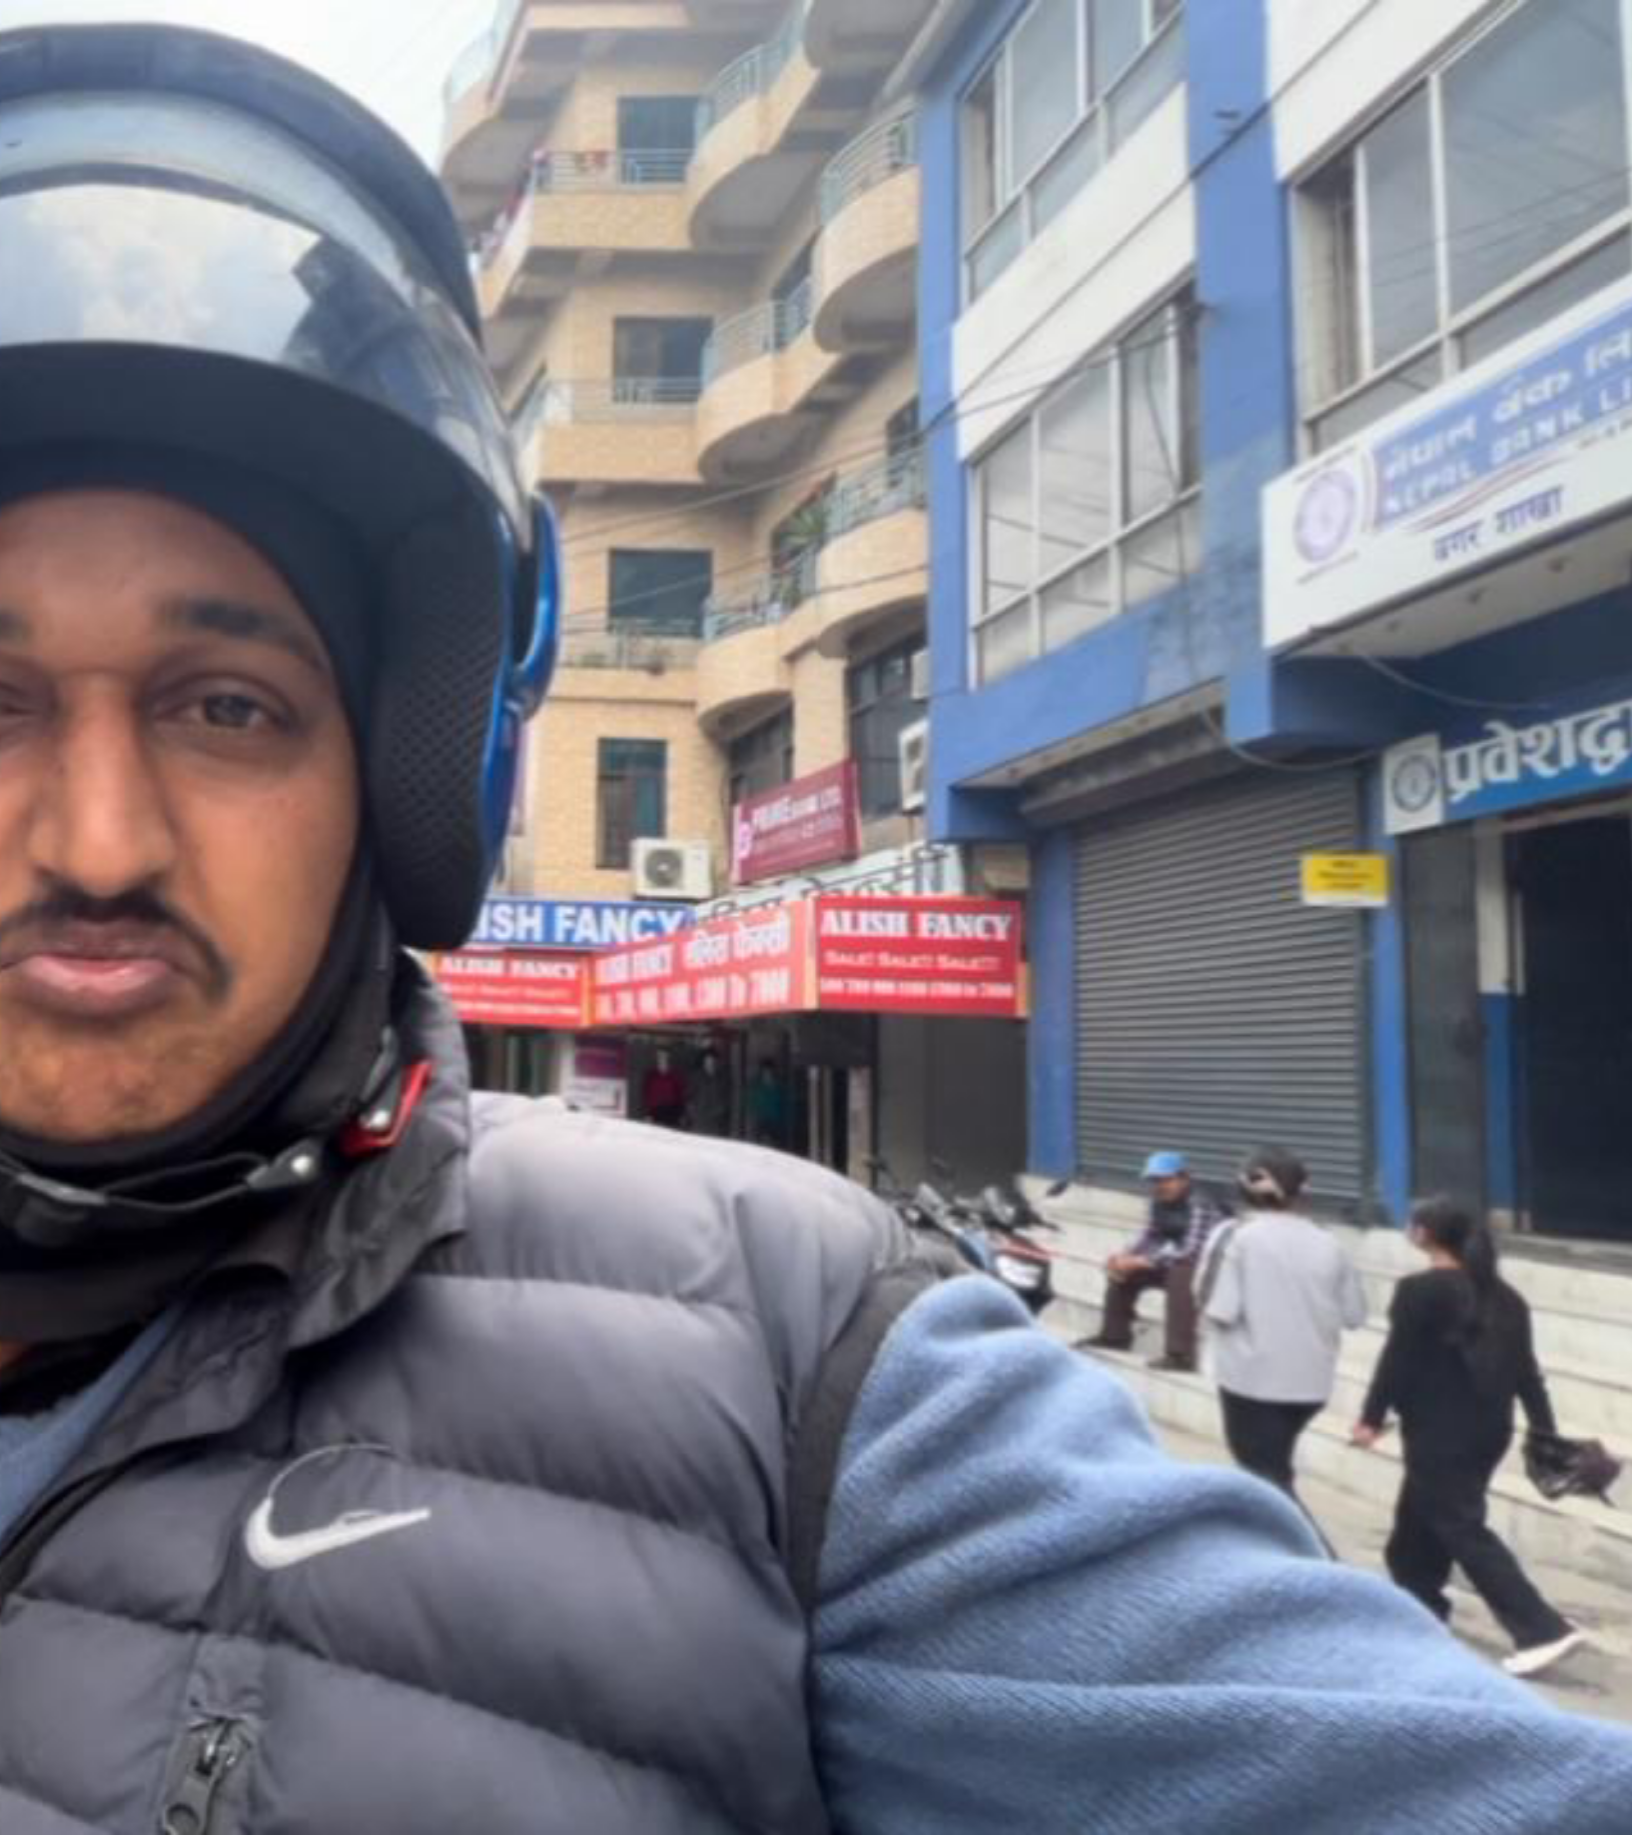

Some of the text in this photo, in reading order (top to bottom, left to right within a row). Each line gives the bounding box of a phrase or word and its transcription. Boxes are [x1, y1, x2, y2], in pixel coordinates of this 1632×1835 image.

[1385, 459, 1477, 513] NEPAL
[1491, 400, 1585, 466] BANK
[1494, 483, 1564, 534] शाखा
[470, 902, 685, 943] ISH FANCY
[820, 910, 1012, 940] ALISH FANCY
